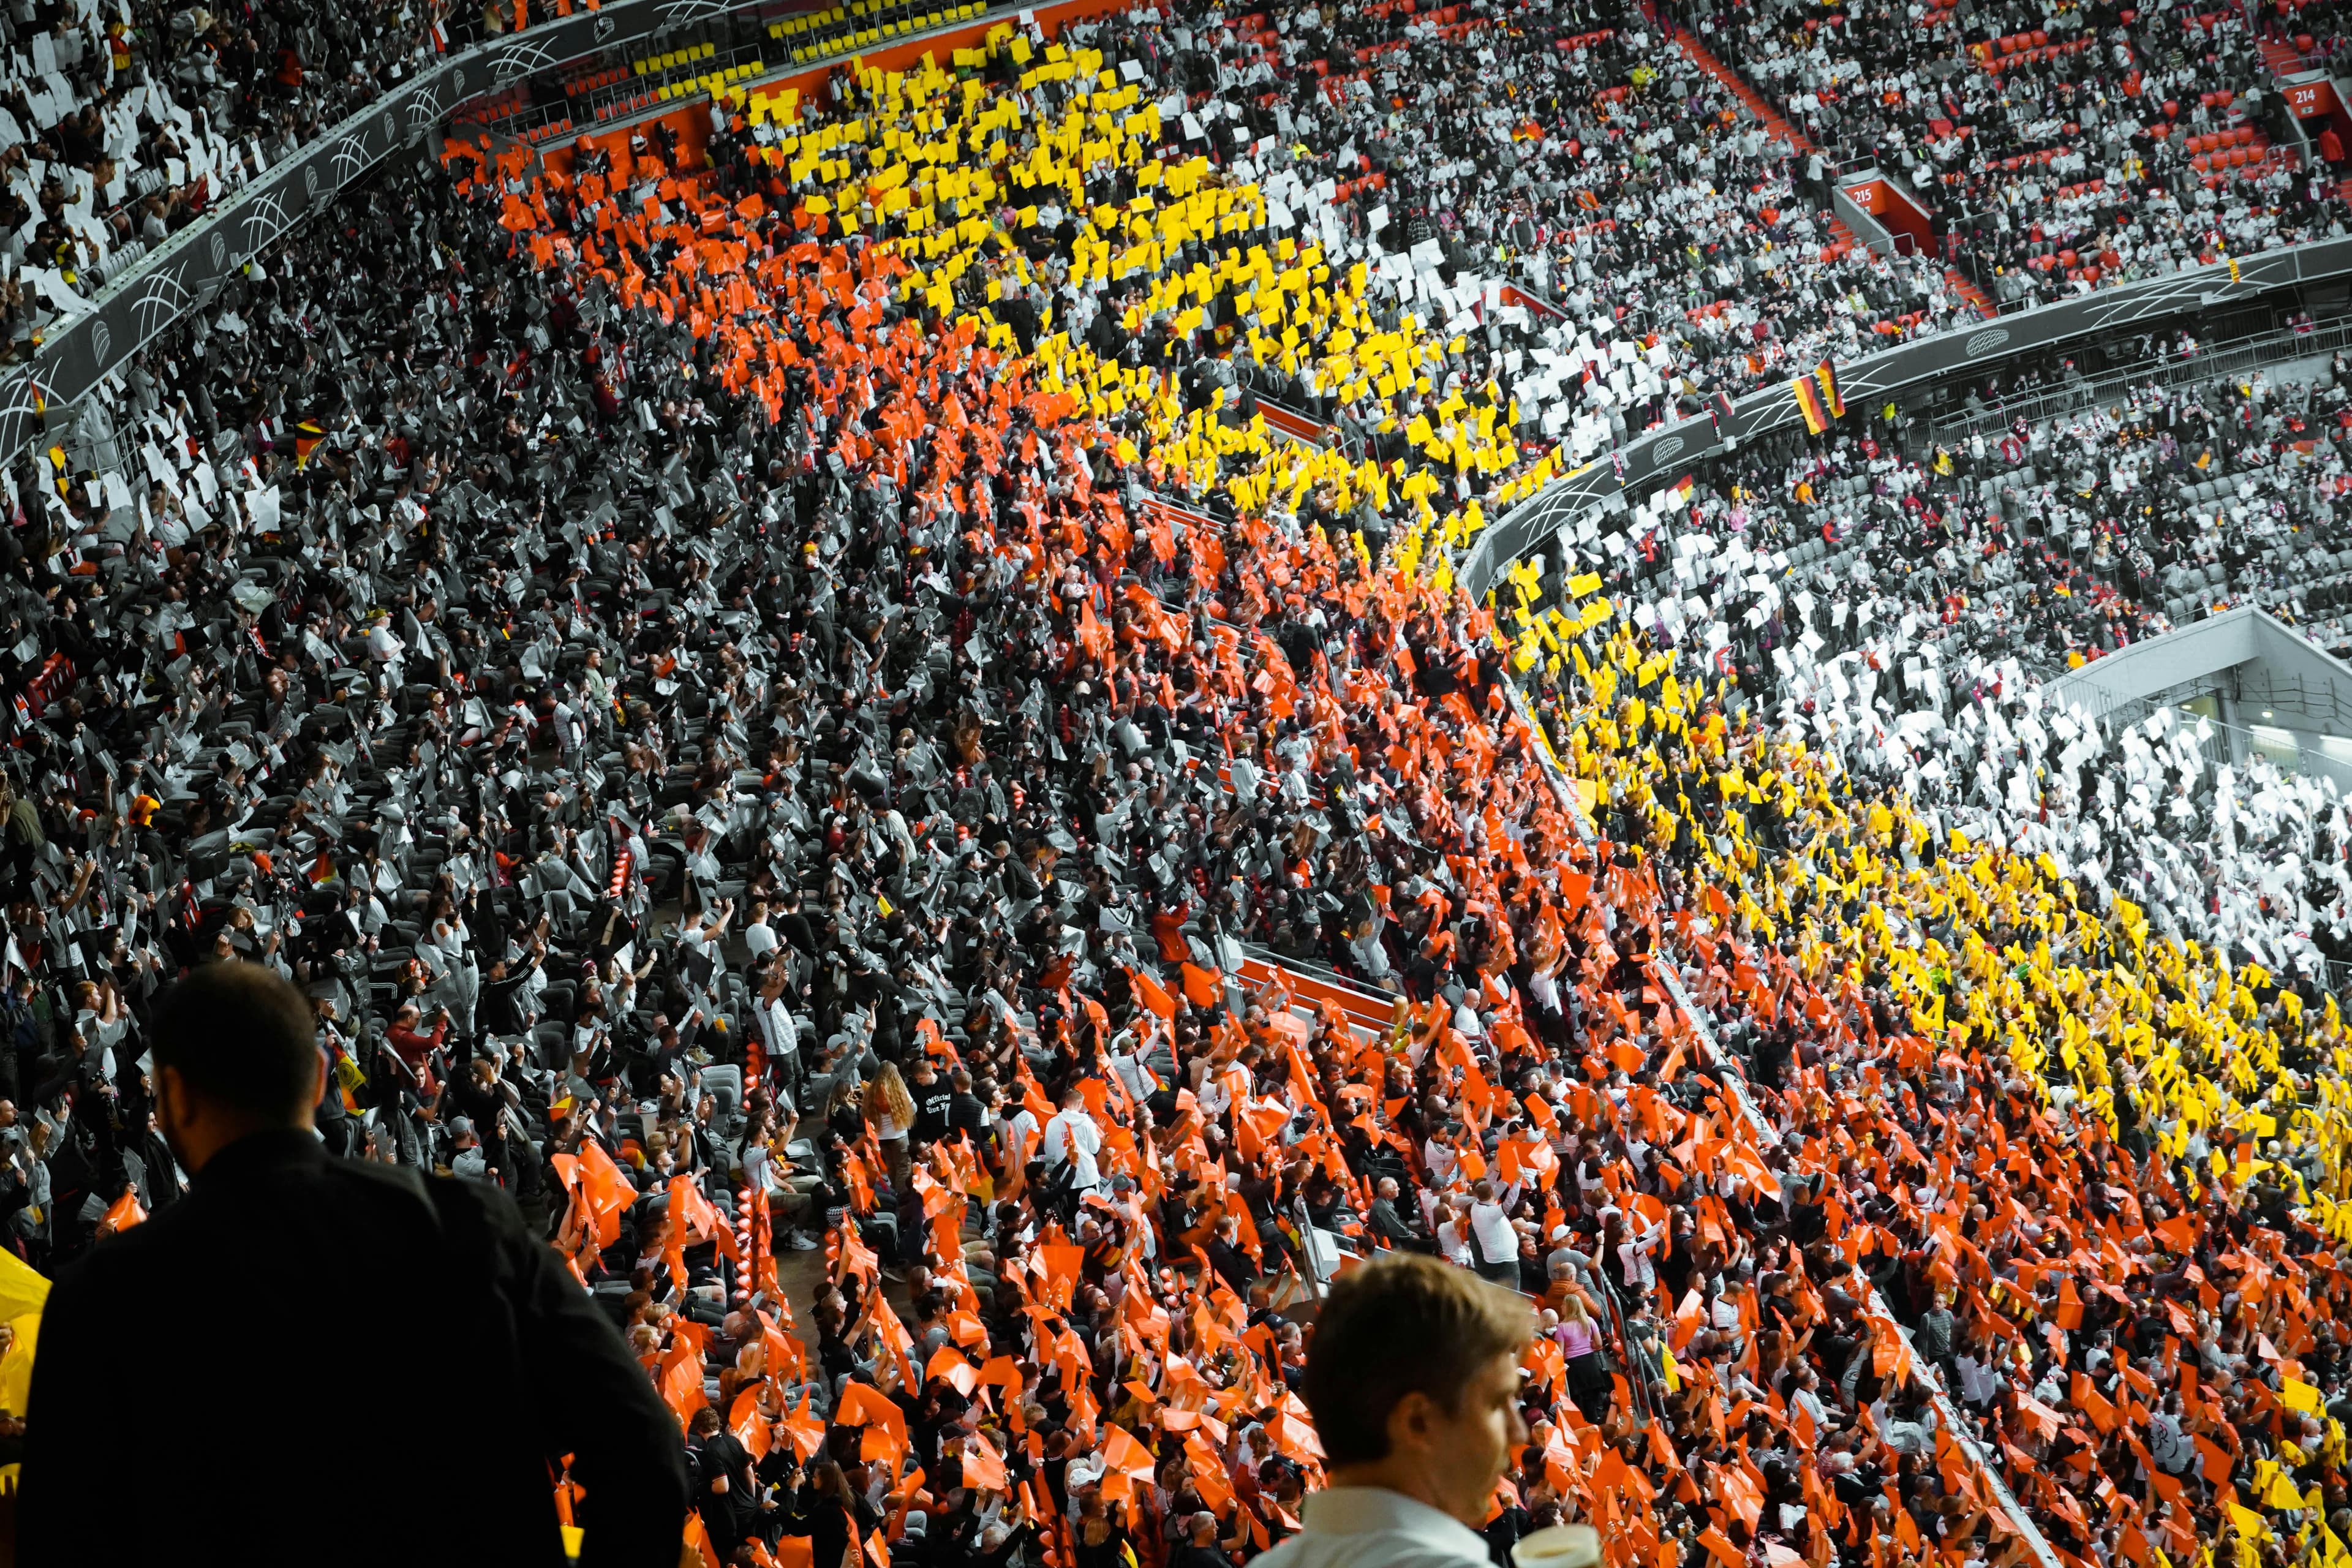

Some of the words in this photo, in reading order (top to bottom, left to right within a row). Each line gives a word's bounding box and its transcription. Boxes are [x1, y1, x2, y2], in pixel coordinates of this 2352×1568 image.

[2295, 89, 2315, 104] 214
[1854, 188, 1872, 203] 215
[925, 1093, 951, 1106] Official
